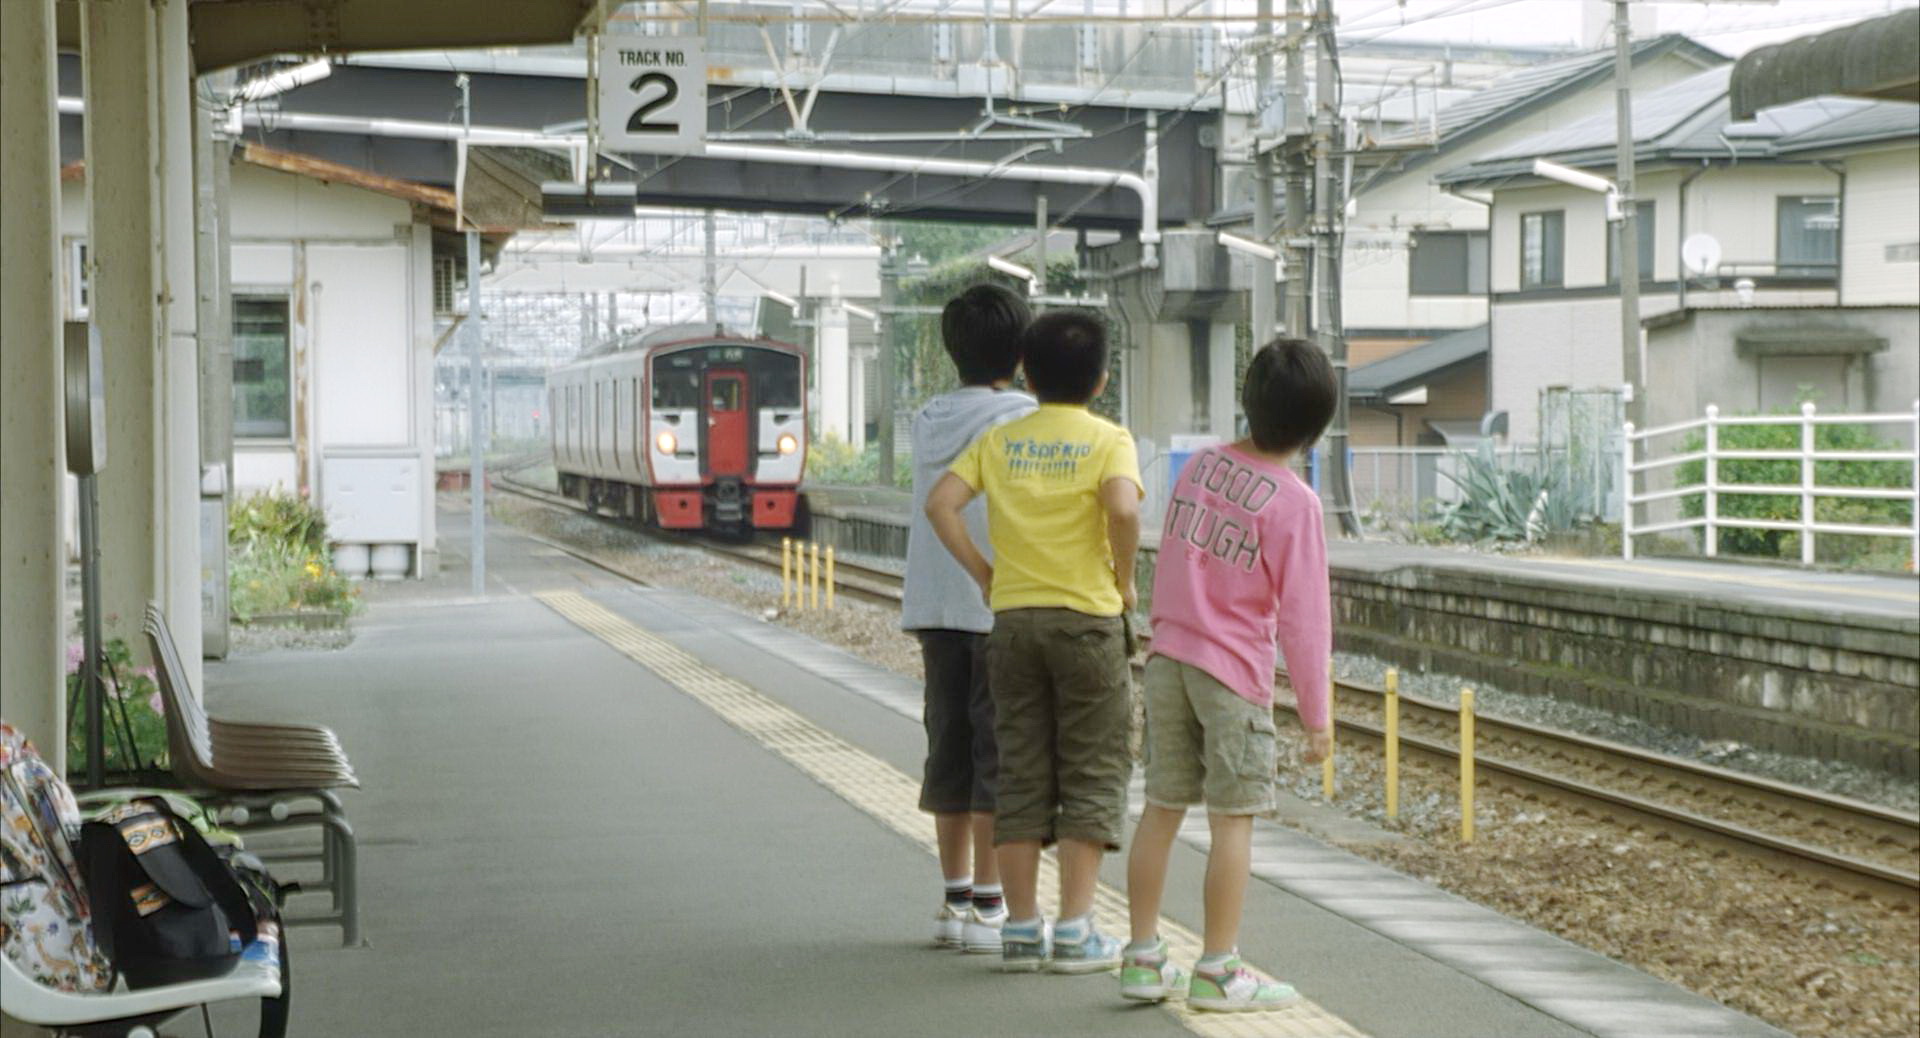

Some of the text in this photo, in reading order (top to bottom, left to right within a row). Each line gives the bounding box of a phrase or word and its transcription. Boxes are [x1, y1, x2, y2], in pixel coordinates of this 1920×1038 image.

[618, 50, 688, 67] TRACK NO.
[626, 71, 680, 135] 2
[1191, 450, 1278, 513] GOOD
[1168, 498, 1260, 571] TOUGH
